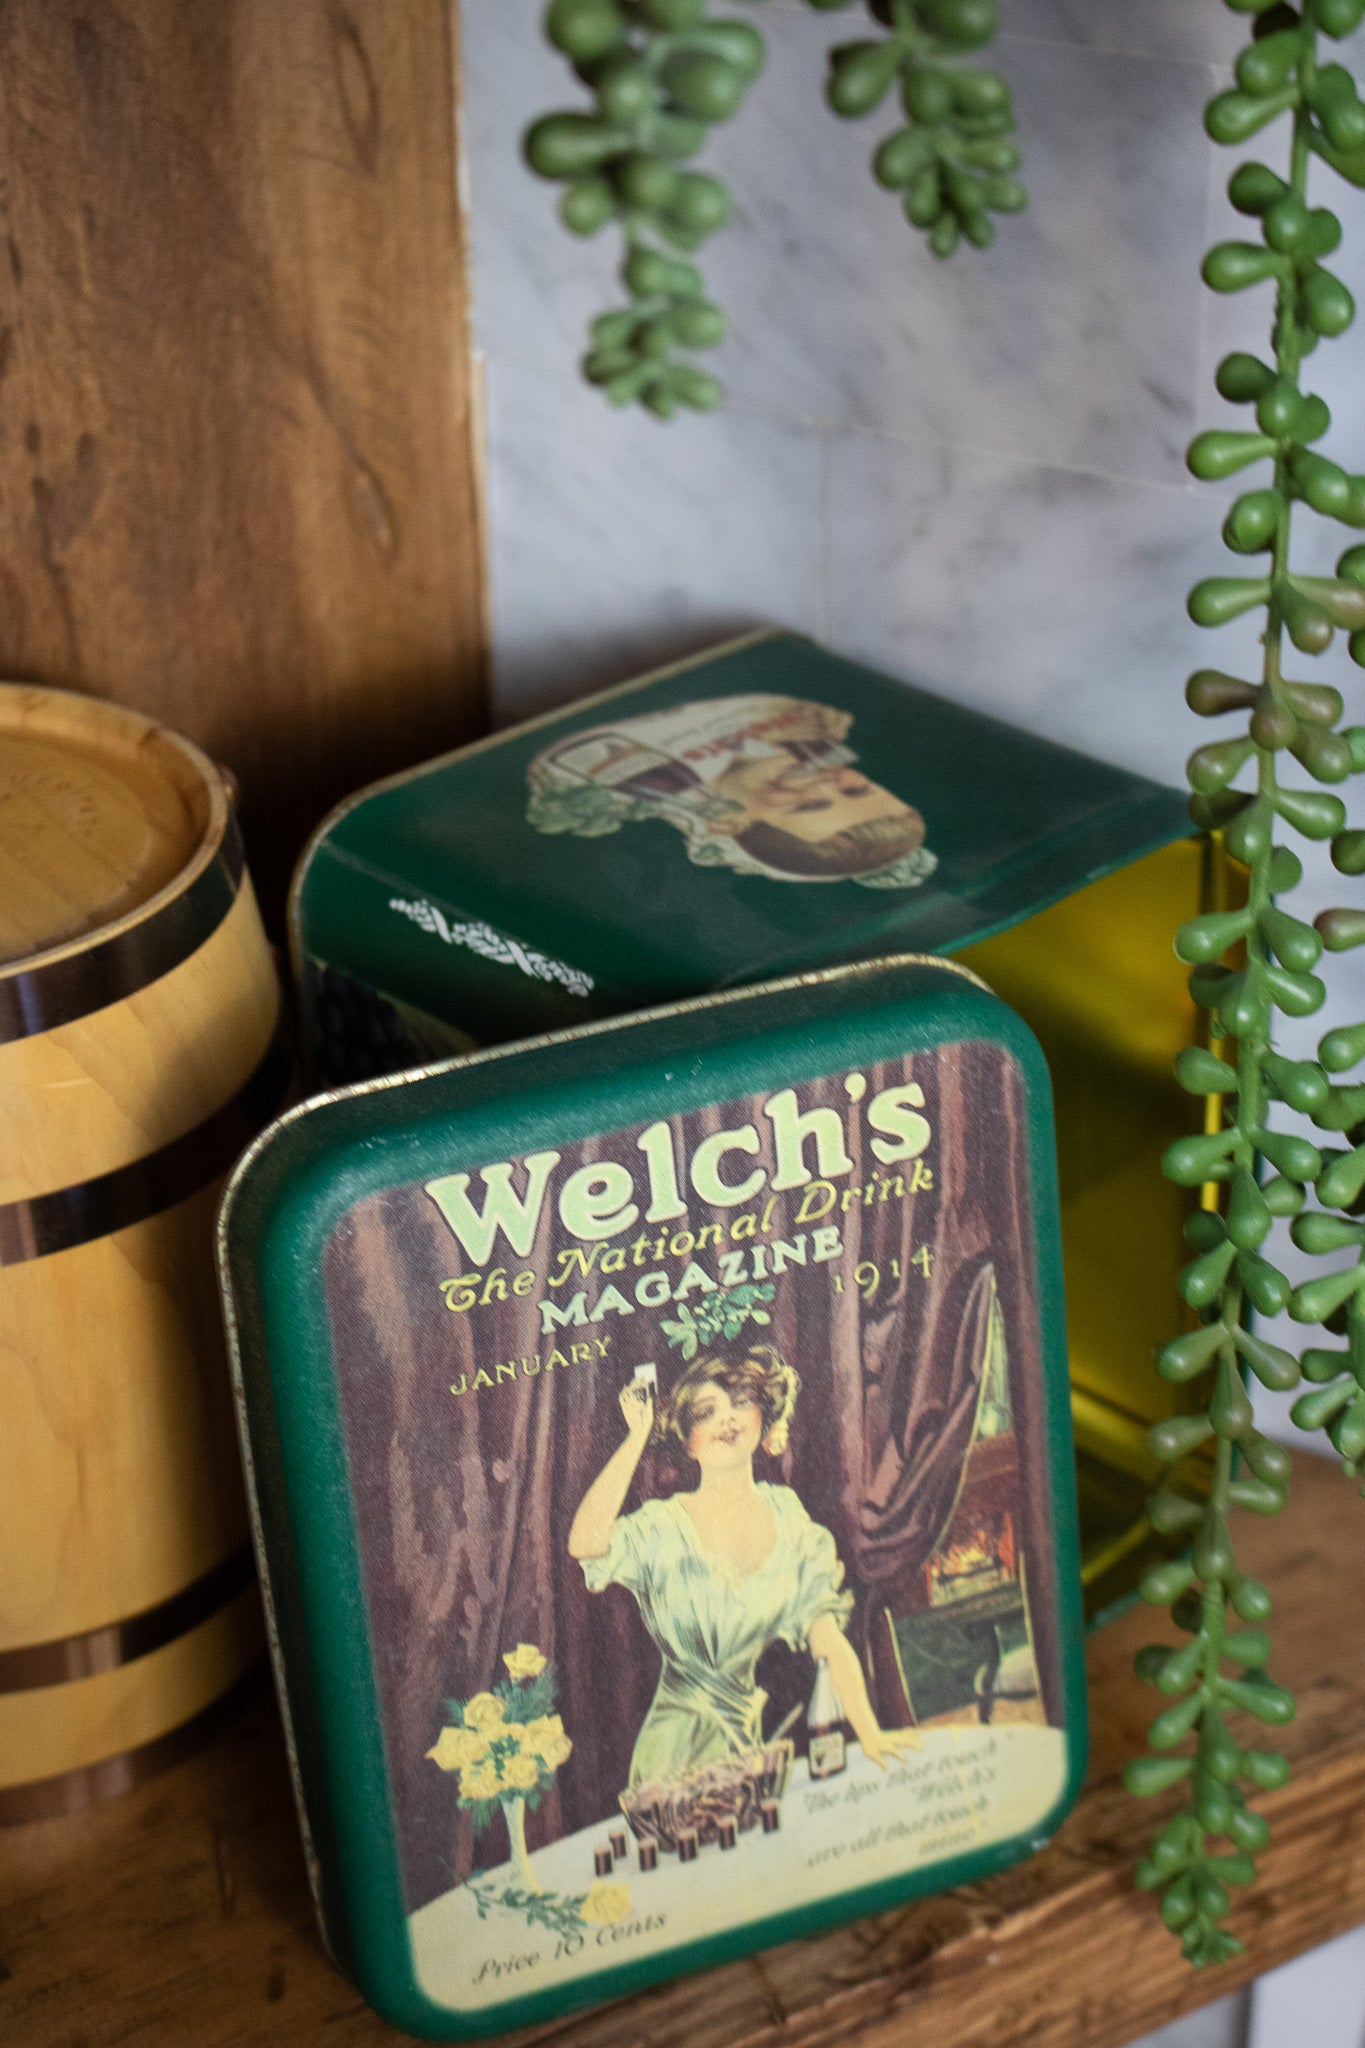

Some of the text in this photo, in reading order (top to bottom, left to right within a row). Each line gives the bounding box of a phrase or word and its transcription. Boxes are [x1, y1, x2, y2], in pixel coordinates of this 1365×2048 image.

[425, 1073, 932, 1267] Welch's
[439, 1159, 935, 1314] The National Drink
[538, 1226, 846, 1335] MAGAZINE
[833, 1244, 936, 1299] 1914
[449, 1335, 612, 1396] JANUARY
[472, 1914, 667, 1985] Price 10 Cents
